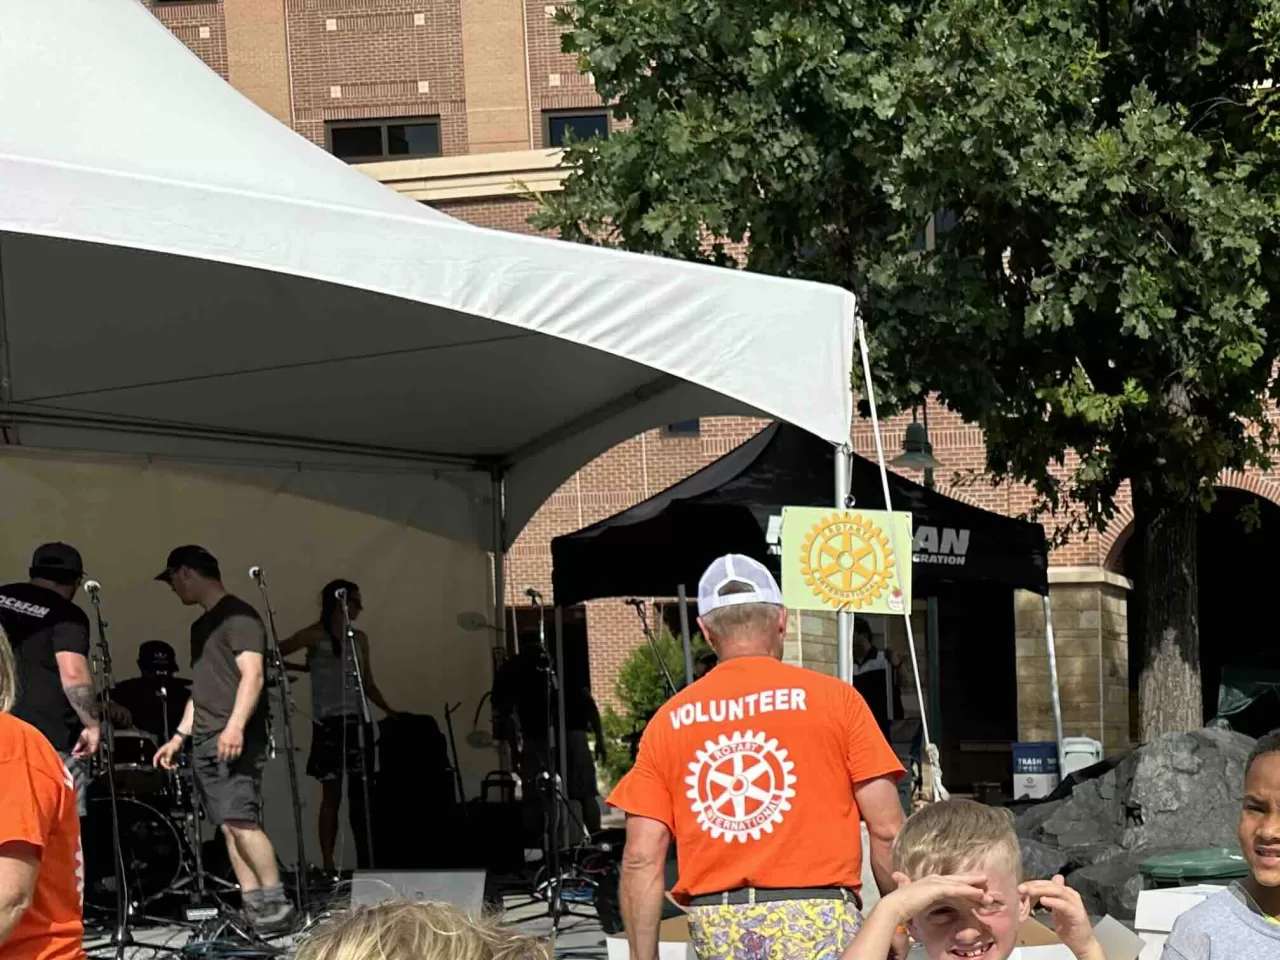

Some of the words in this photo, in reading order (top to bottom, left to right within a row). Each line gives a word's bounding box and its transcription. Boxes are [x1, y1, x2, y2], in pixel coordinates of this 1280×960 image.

[670, 688, 807, 730] VOLUNTEER
[713, 742, 761, 759] ROTARY
[1017, 757, 1042, 765] TRASH
[705, 799, 782, 831] INTERNATIONAL
